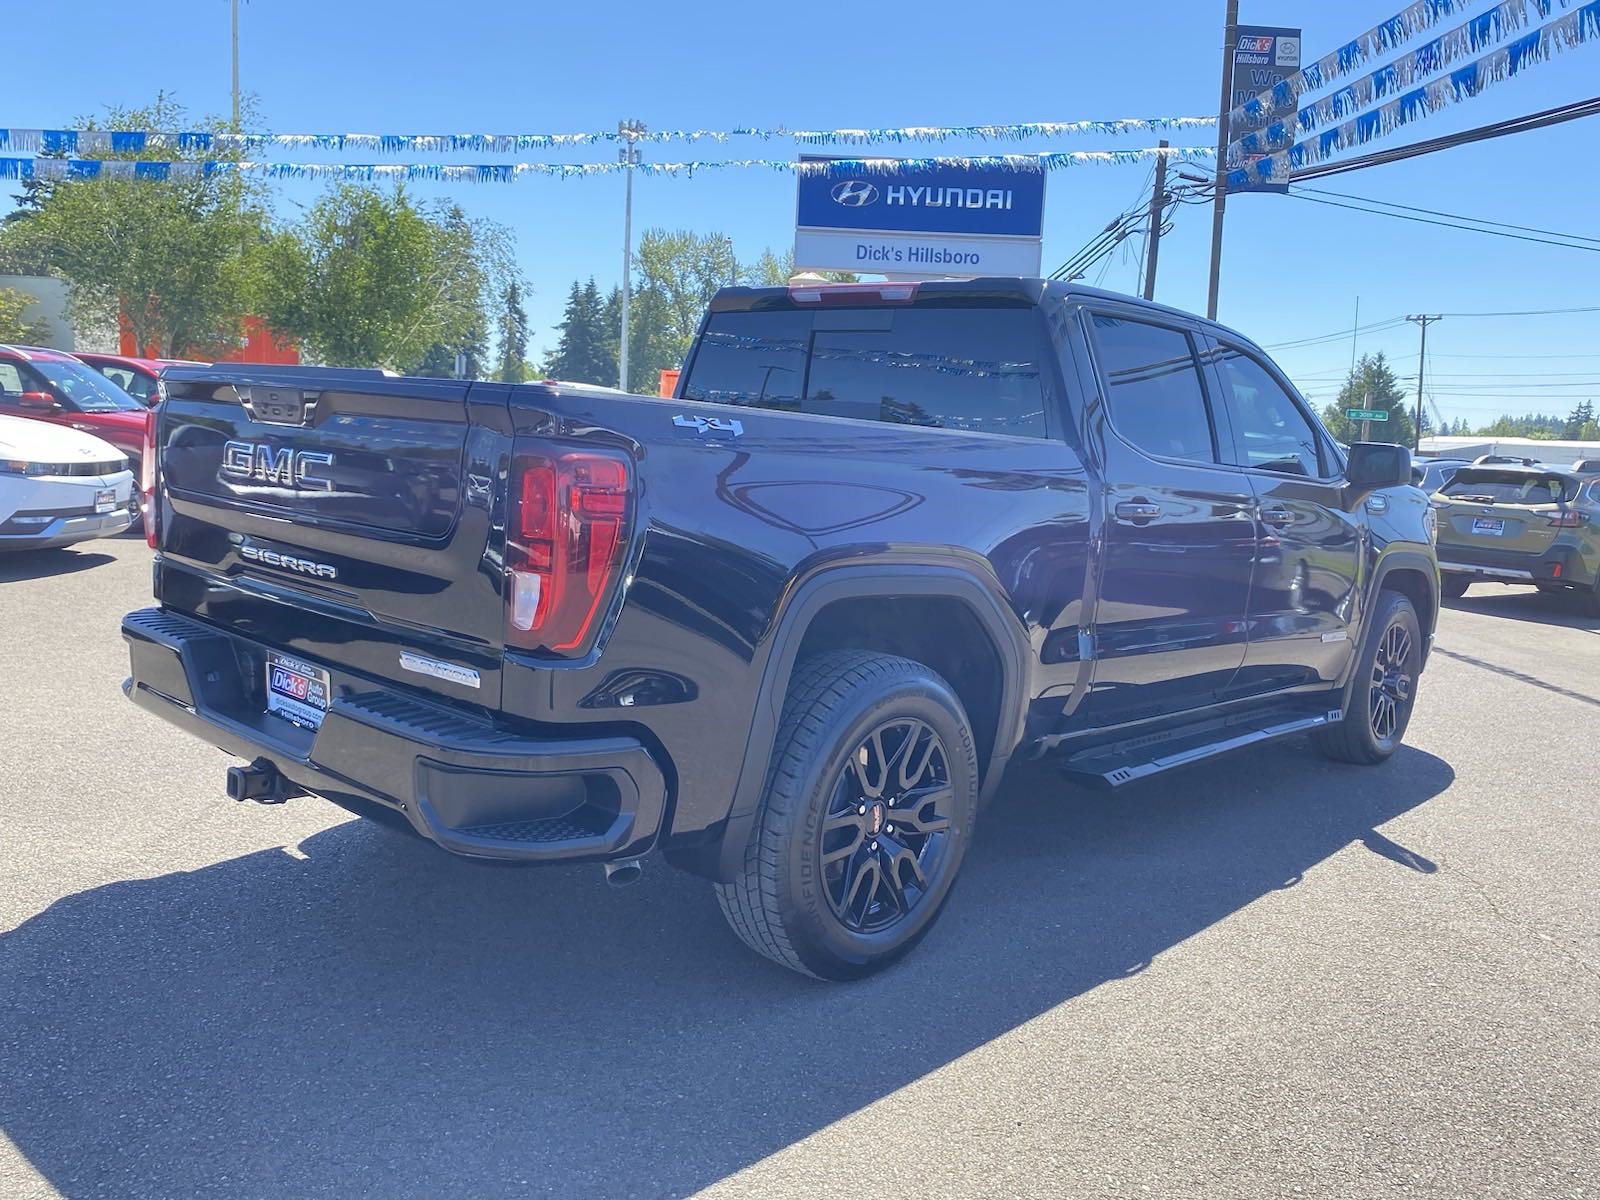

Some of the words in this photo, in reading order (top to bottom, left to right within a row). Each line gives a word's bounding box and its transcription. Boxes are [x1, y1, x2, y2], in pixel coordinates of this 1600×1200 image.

[1240, 37, 1270, 51] Dick's
[1236, 53, 1269, 65] Hillsboro
[1250, 69, 1285, 86] We
[886, 185, 1012, 210] HYUNDAI
[856, 244, 903, 262] Dick's
[907, 247, 980, 266] Hillsboro
[223, 440, 334, 491] GMC
[241, 545, 338, 579] SIERRA
[274, 671, 306, 696] Dick's
[308, 681, 323, 696] Auto
[307, 692, 327, 710] Group
